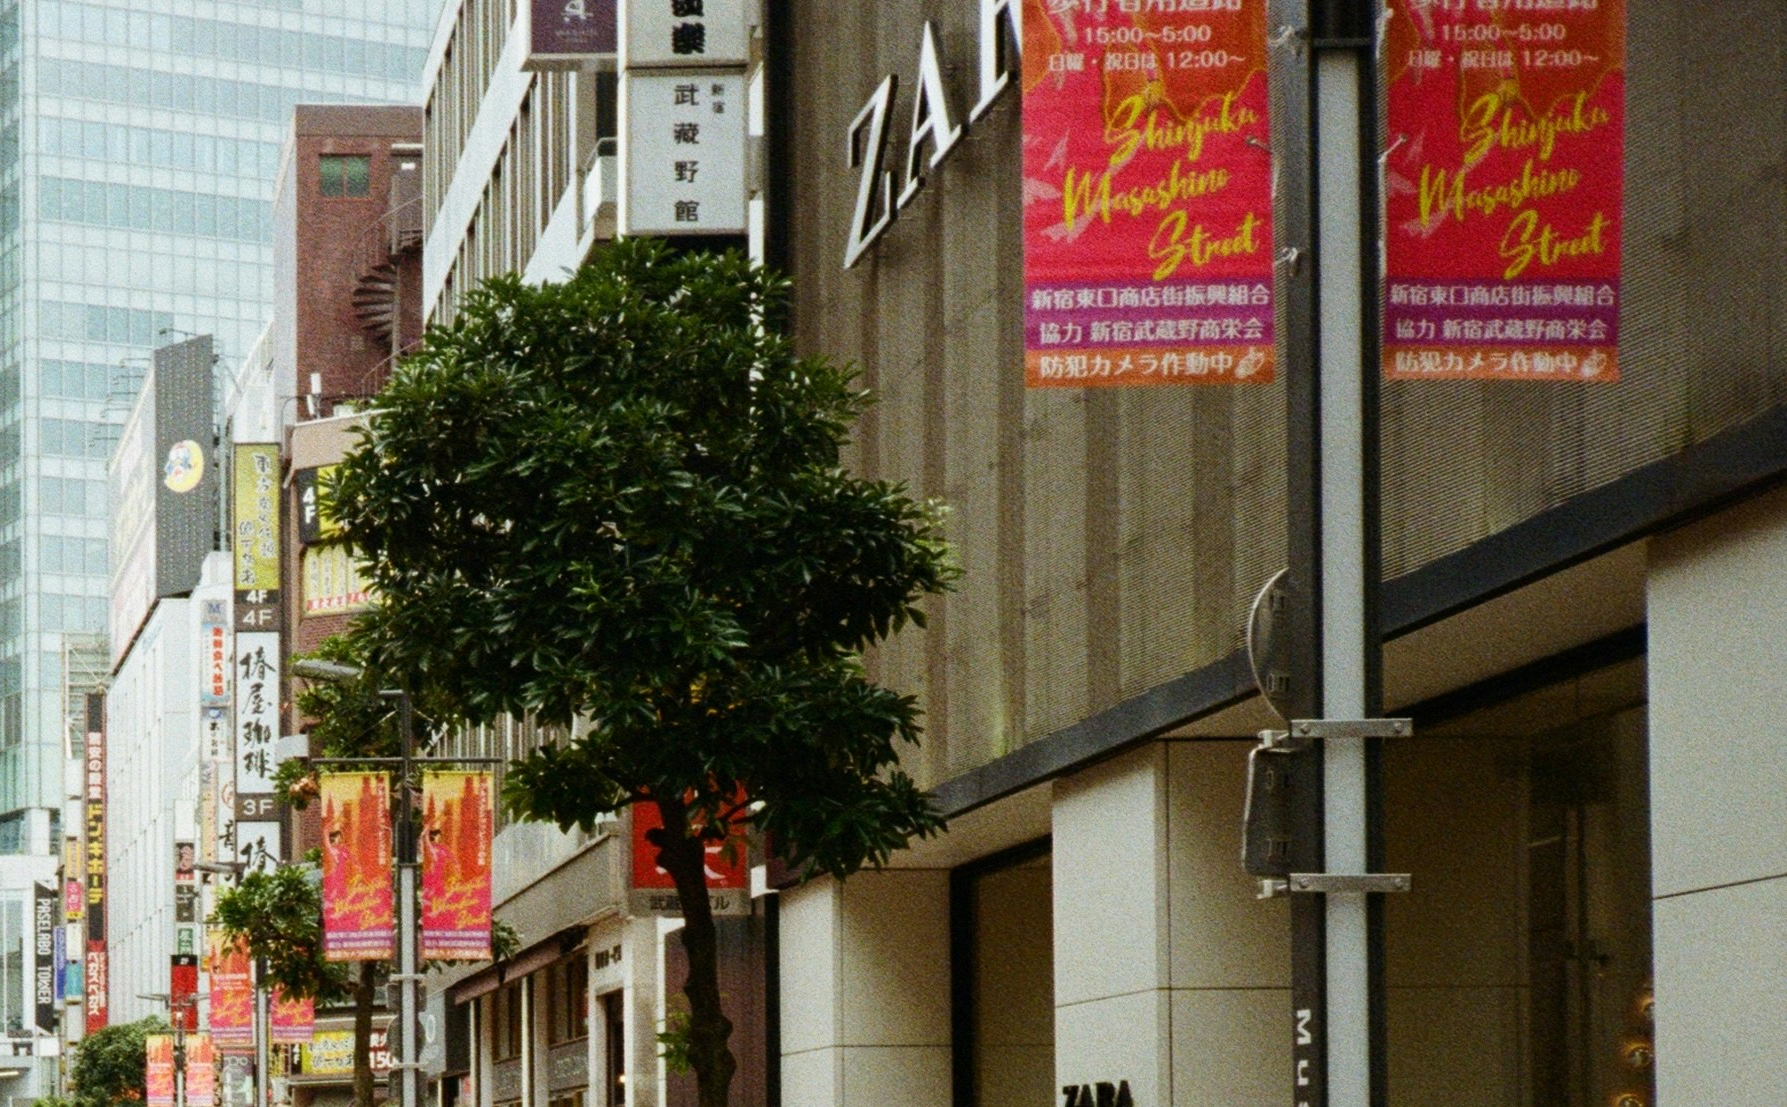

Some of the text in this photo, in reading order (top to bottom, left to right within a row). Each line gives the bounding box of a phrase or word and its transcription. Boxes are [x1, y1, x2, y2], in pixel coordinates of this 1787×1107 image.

[1105, 92, 1258, 165] Shinjuku
[1460, 91, 1609, 164] Shinjuku
[1063, 160, 1231, 231] Musashino
[1419, 159, 1580, 229] Musashino
[1148, 210, 1262, 281] Street
[1498, 210, 1611, 280] Street
[242, 609, 273, 626] 4F
[239, 646, 276, 779] 椿屋珈琲
[243, 801, 274, 816] 3F
[37, 898, 51, 1005] PASELABO TOWER
